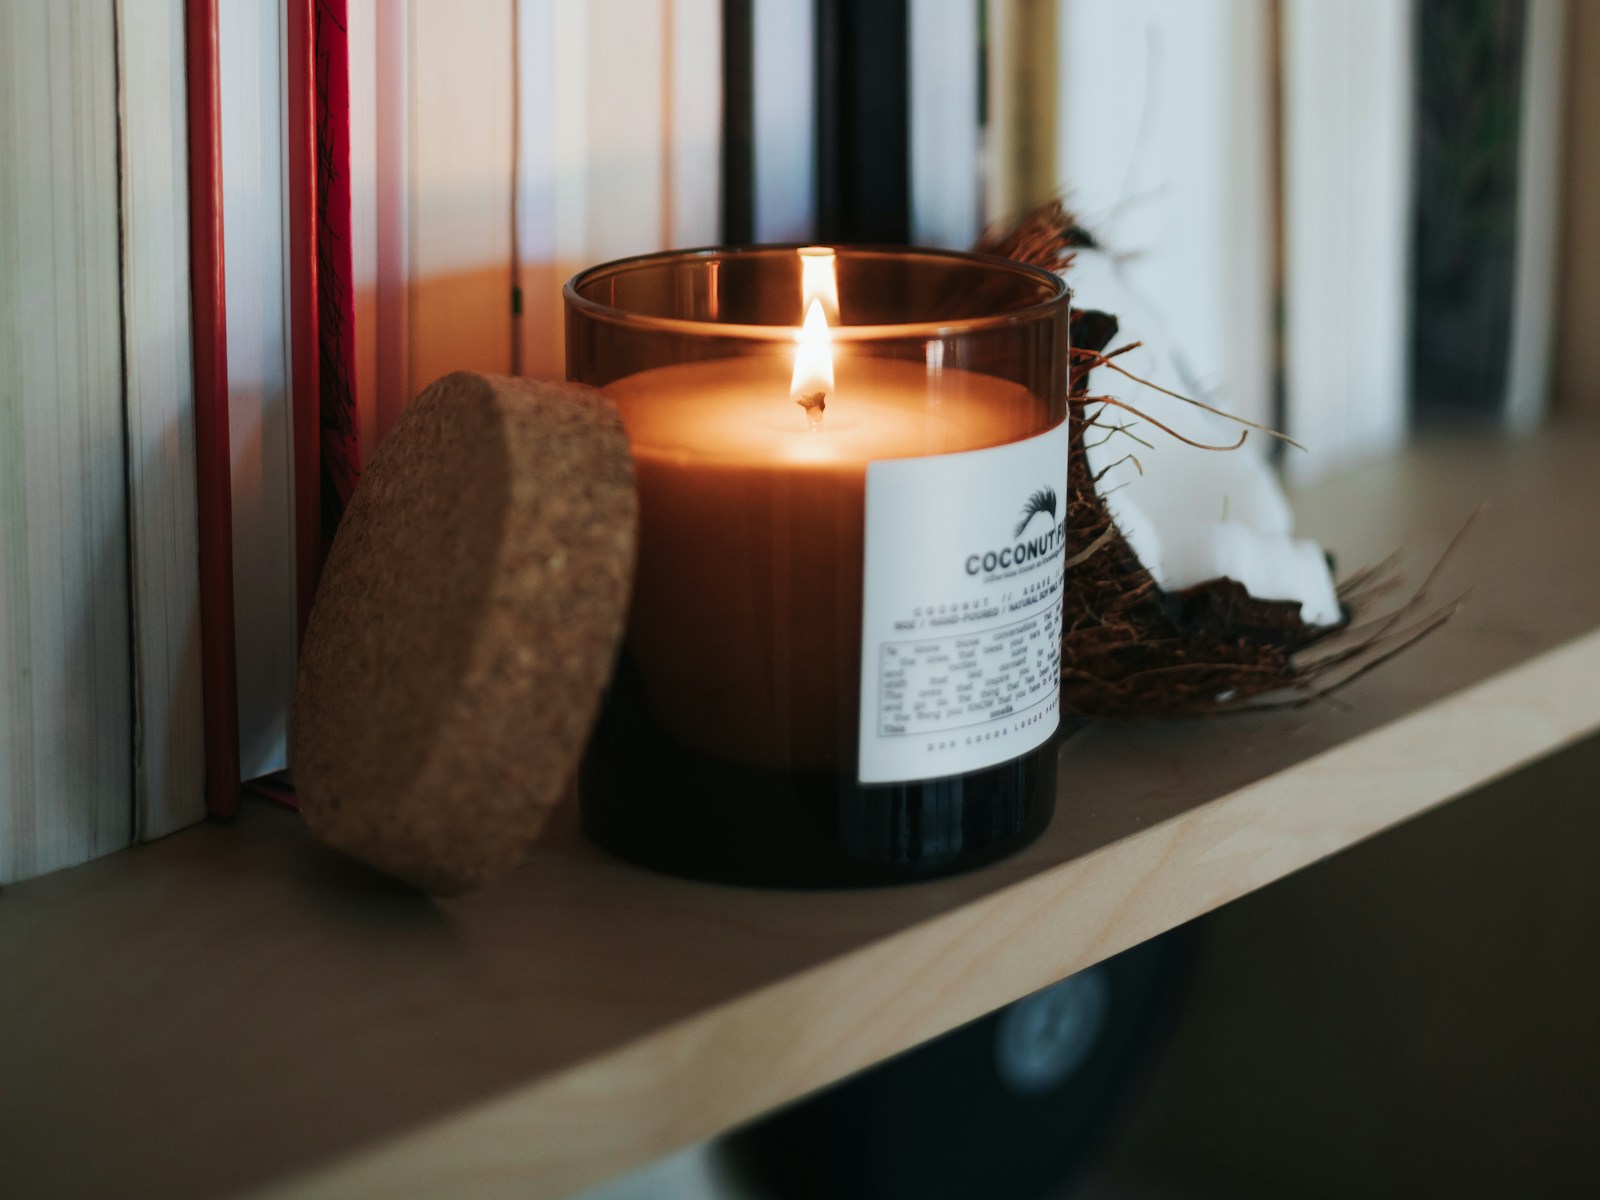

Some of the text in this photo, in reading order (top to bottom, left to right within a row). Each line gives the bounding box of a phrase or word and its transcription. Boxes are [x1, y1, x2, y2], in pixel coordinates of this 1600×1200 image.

[964, 528, 1055, 576] COCONUT
[913, 597, 989, 617] COCONUT
[1023, 575, 1050, 596] AGAVE
[1009, 593, 1038, 611] NATURAL
